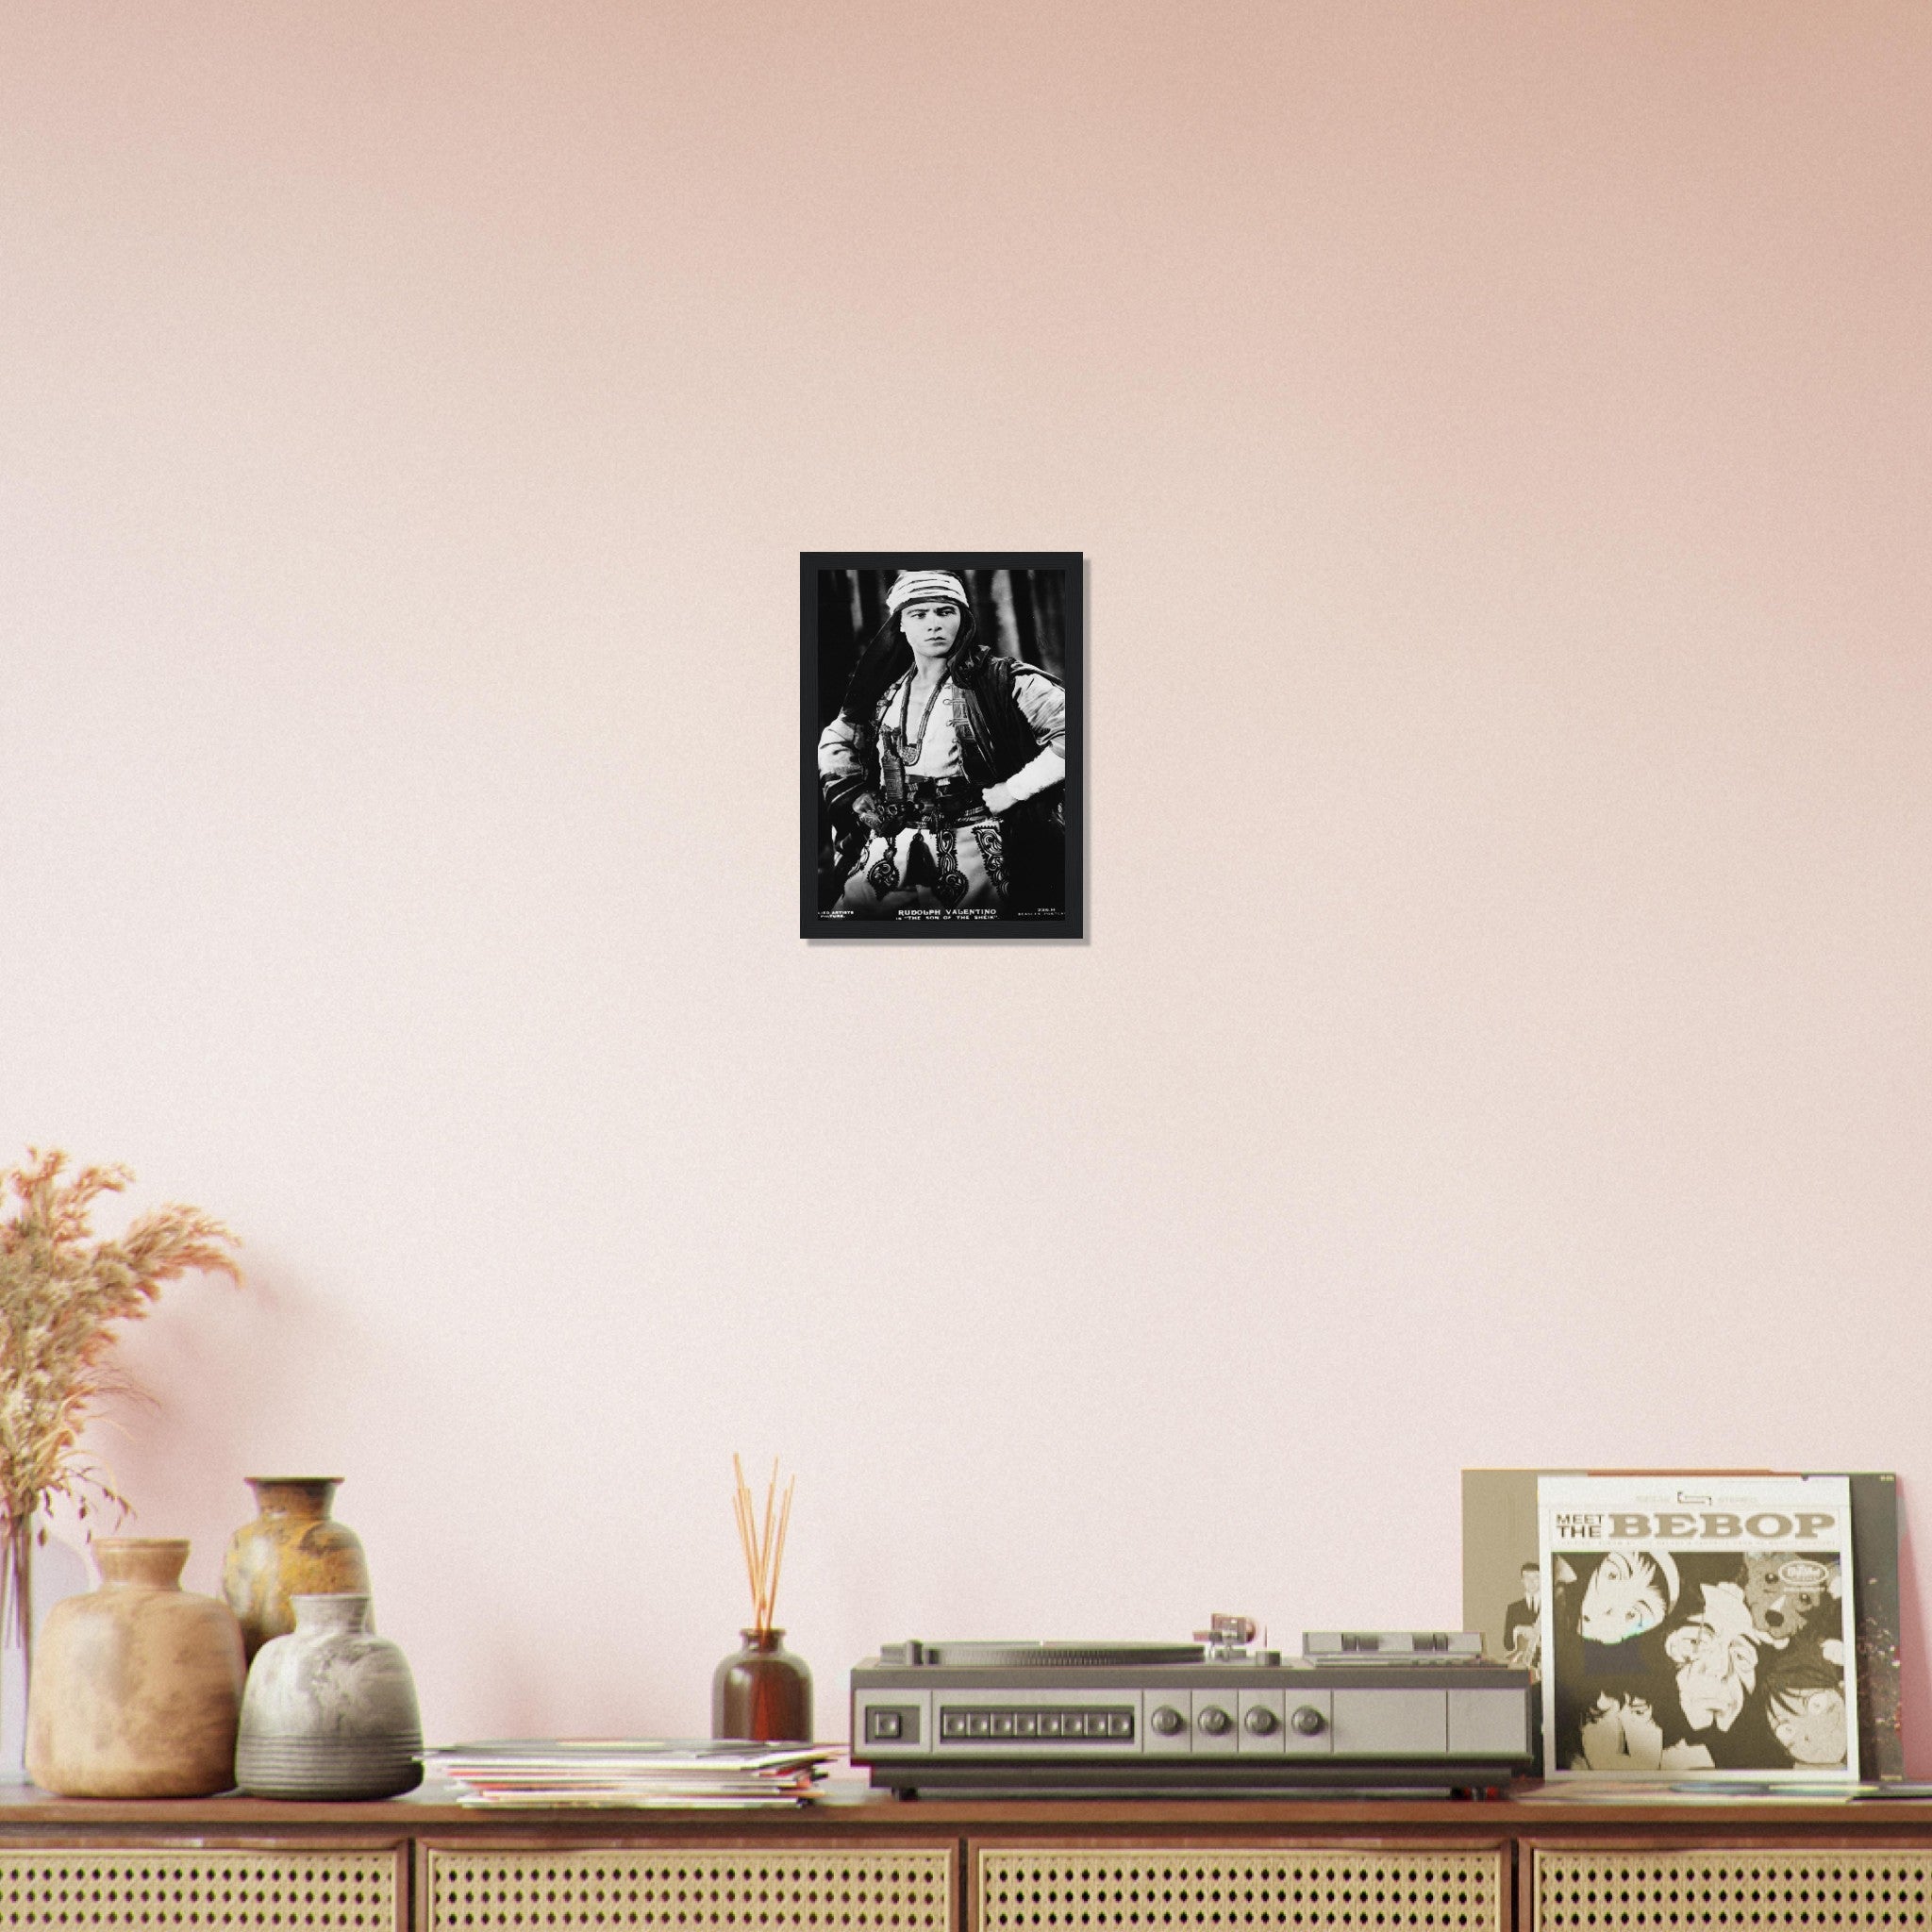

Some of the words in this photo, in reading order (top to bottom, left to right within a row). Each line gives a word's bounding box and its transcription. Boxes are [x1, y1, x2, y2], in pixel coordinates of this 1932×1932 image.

[1556, 1513, 1604, 1524] MEET
[1607, 1511, 1836, 1540] BEBOP
[1556, 1524, 1602, 1538] THE
